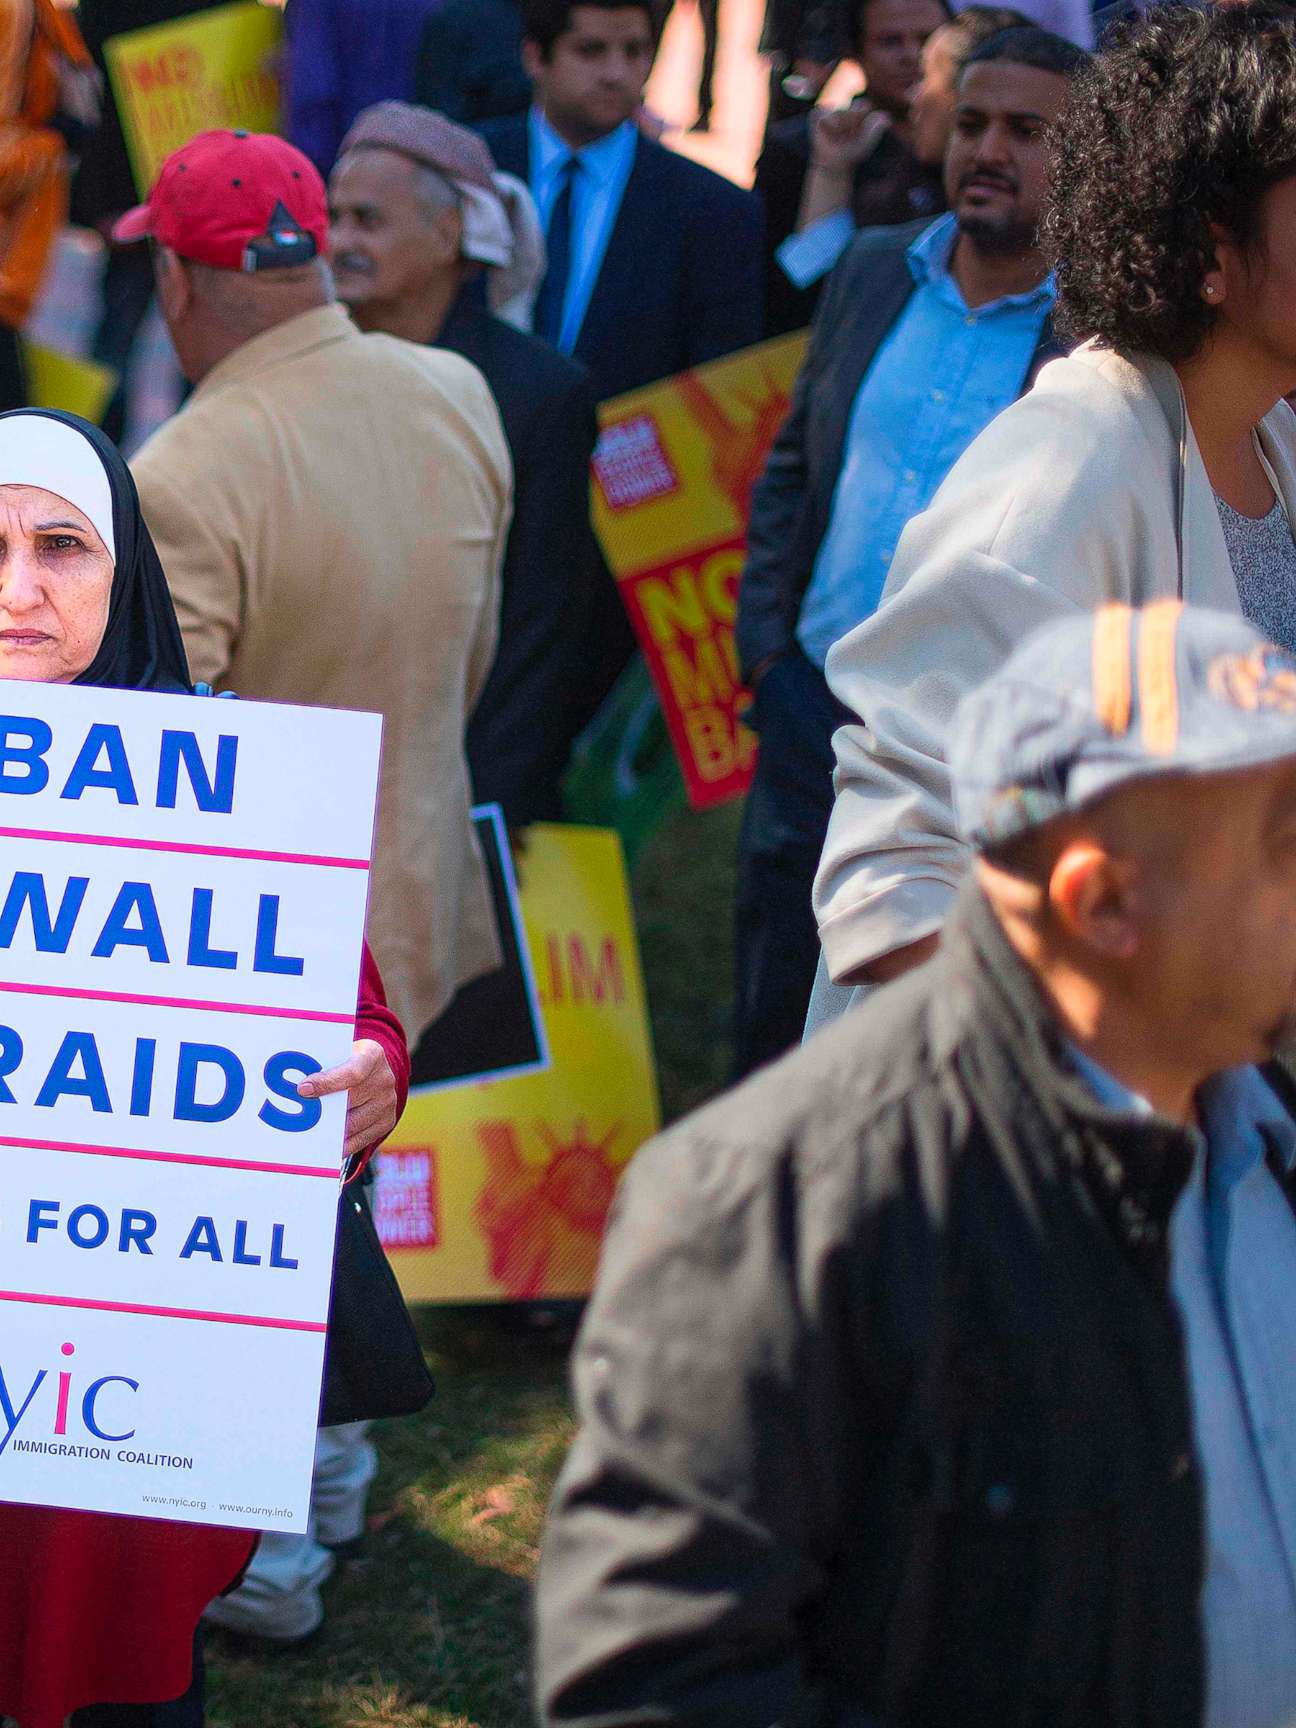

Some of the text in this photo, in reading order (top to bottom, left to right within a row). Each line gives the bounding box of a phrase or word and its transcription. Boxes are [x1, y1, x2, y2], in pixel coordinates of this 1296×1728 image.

[25, 1198, 158, 1256] FOR
[179, 1215, 299, 1270] ALL
[12, 1439, 111, 1461] IMMIGRATION
[116, 1450, 194, 1470] COALITION
[141, 1494, 294, 1519] www.nyic.org www.ourny.info
